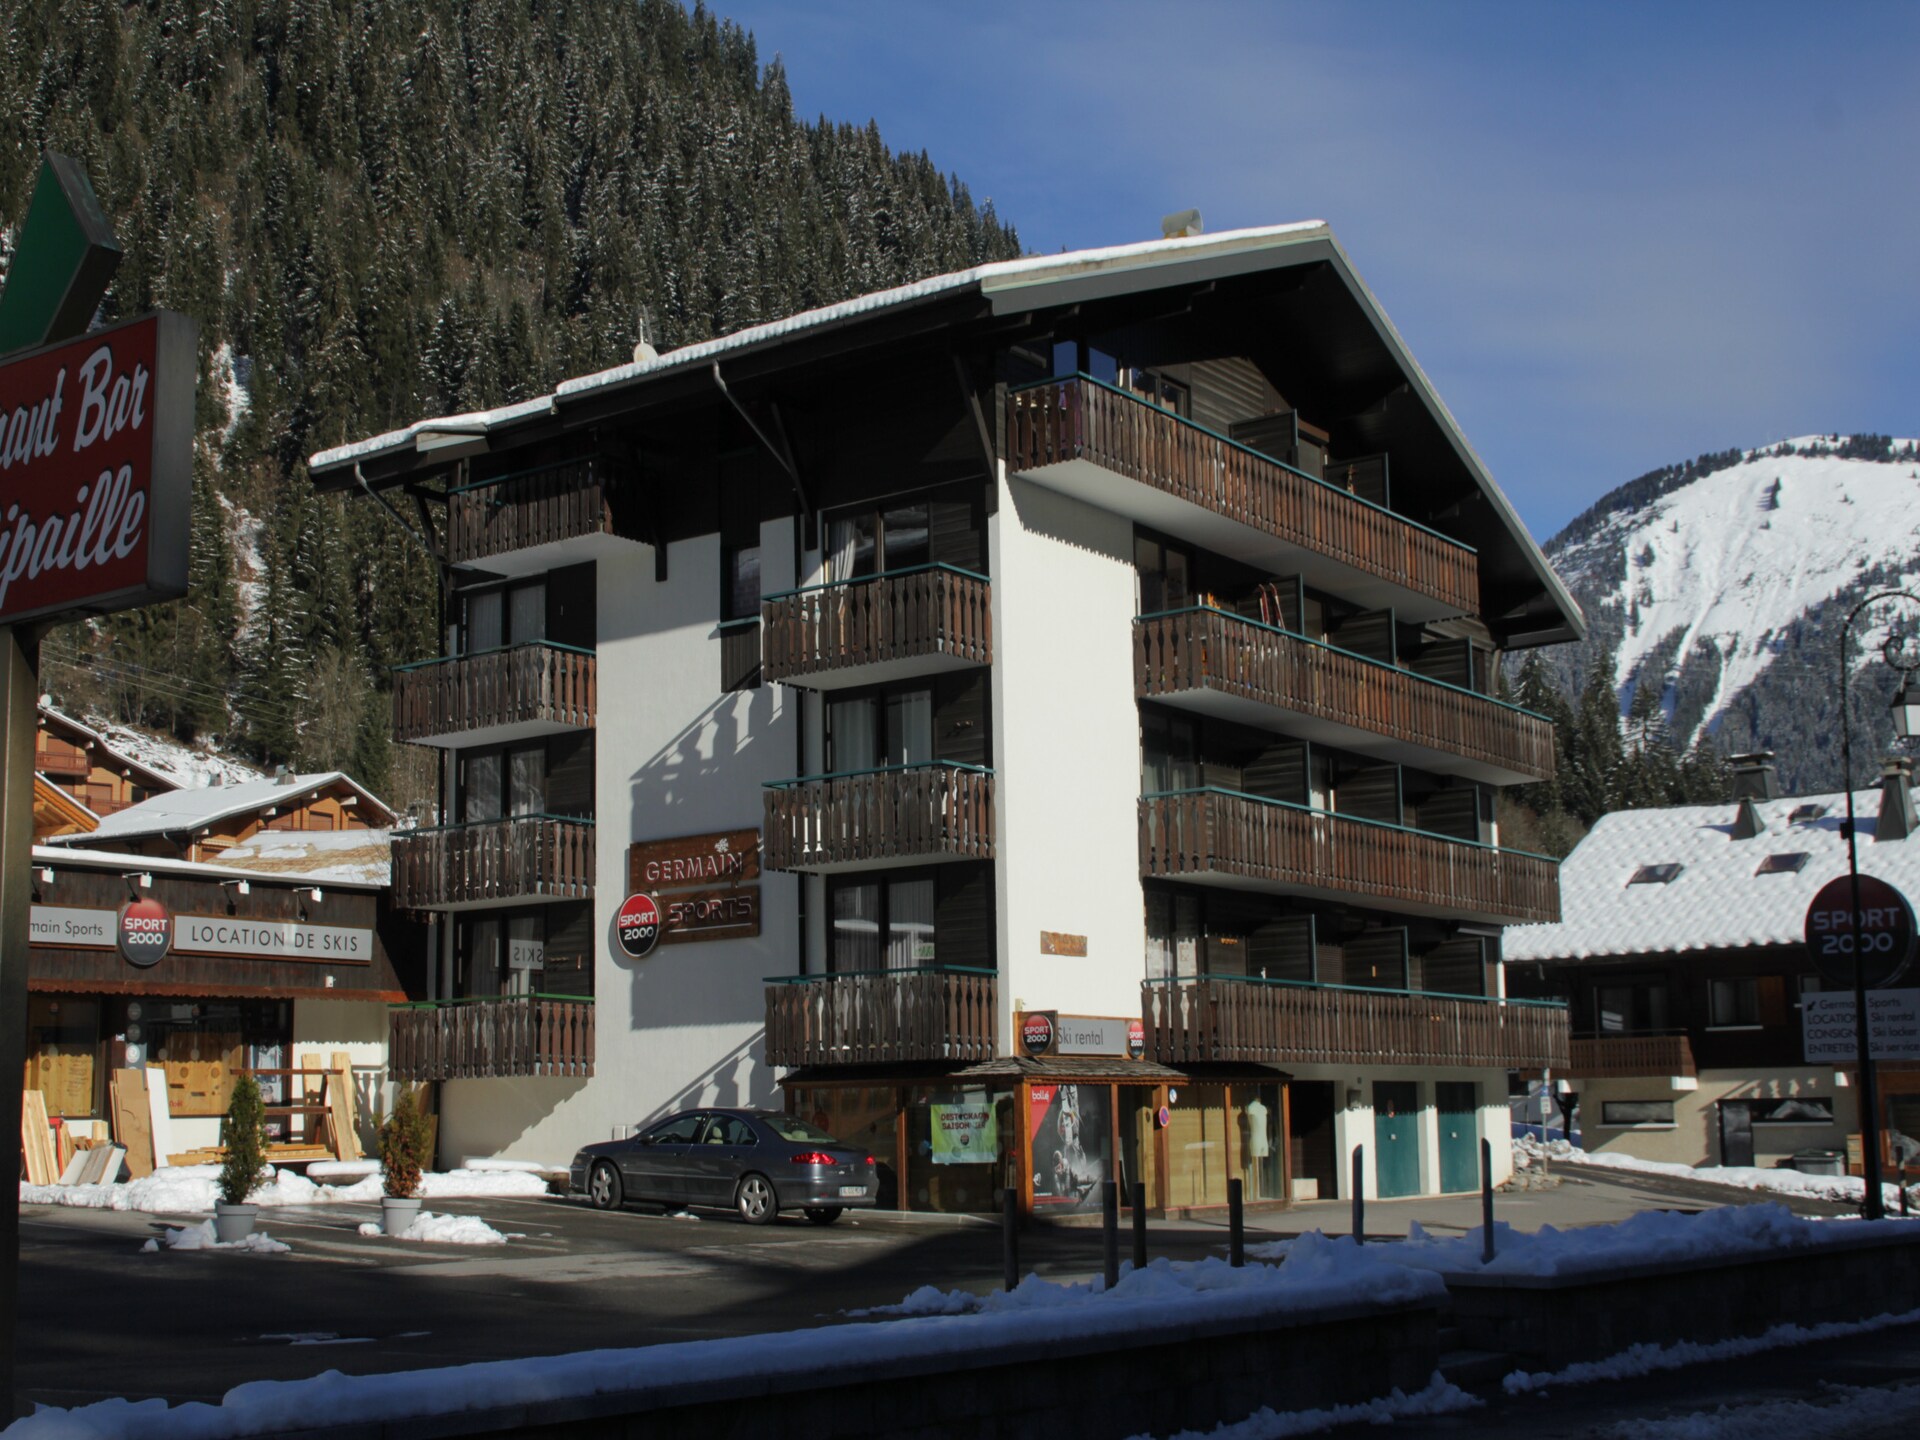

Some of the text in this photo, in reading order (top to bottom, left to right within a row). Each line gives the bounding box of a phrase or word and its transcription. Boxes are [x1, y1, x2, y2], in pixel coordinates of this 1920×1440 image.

[73, 345, 148, 452] Bar
[0, 464, 146, 609] ipaille
[646, 851, 743, 881] GERMAIN
[668, 895, 752, 922] SPORTS
[124, 918, 168, 931] SPORT
[619, 911, 655, 926] SPORT
[1813, 907, 1900, 930] SPORT
[30, 920, 103, 938] main Sports
[623, 926, 654, 940] 2000
[127, 932, 164, 945] 2000
[191, 925, 358, 952] LOCATION DE SKIS
[1821, 932, 1894, 954] 2000
[1819, 998, 1902, 1009] Germa Sports
[1024, 1025, 1049, 1035] SPORT
[1026, 1035, 1048, 1043] 2000
[1058, 1026, 1104, 1046] Ski rental
[1807, 1028, 1857, 1040] CONSIGN
